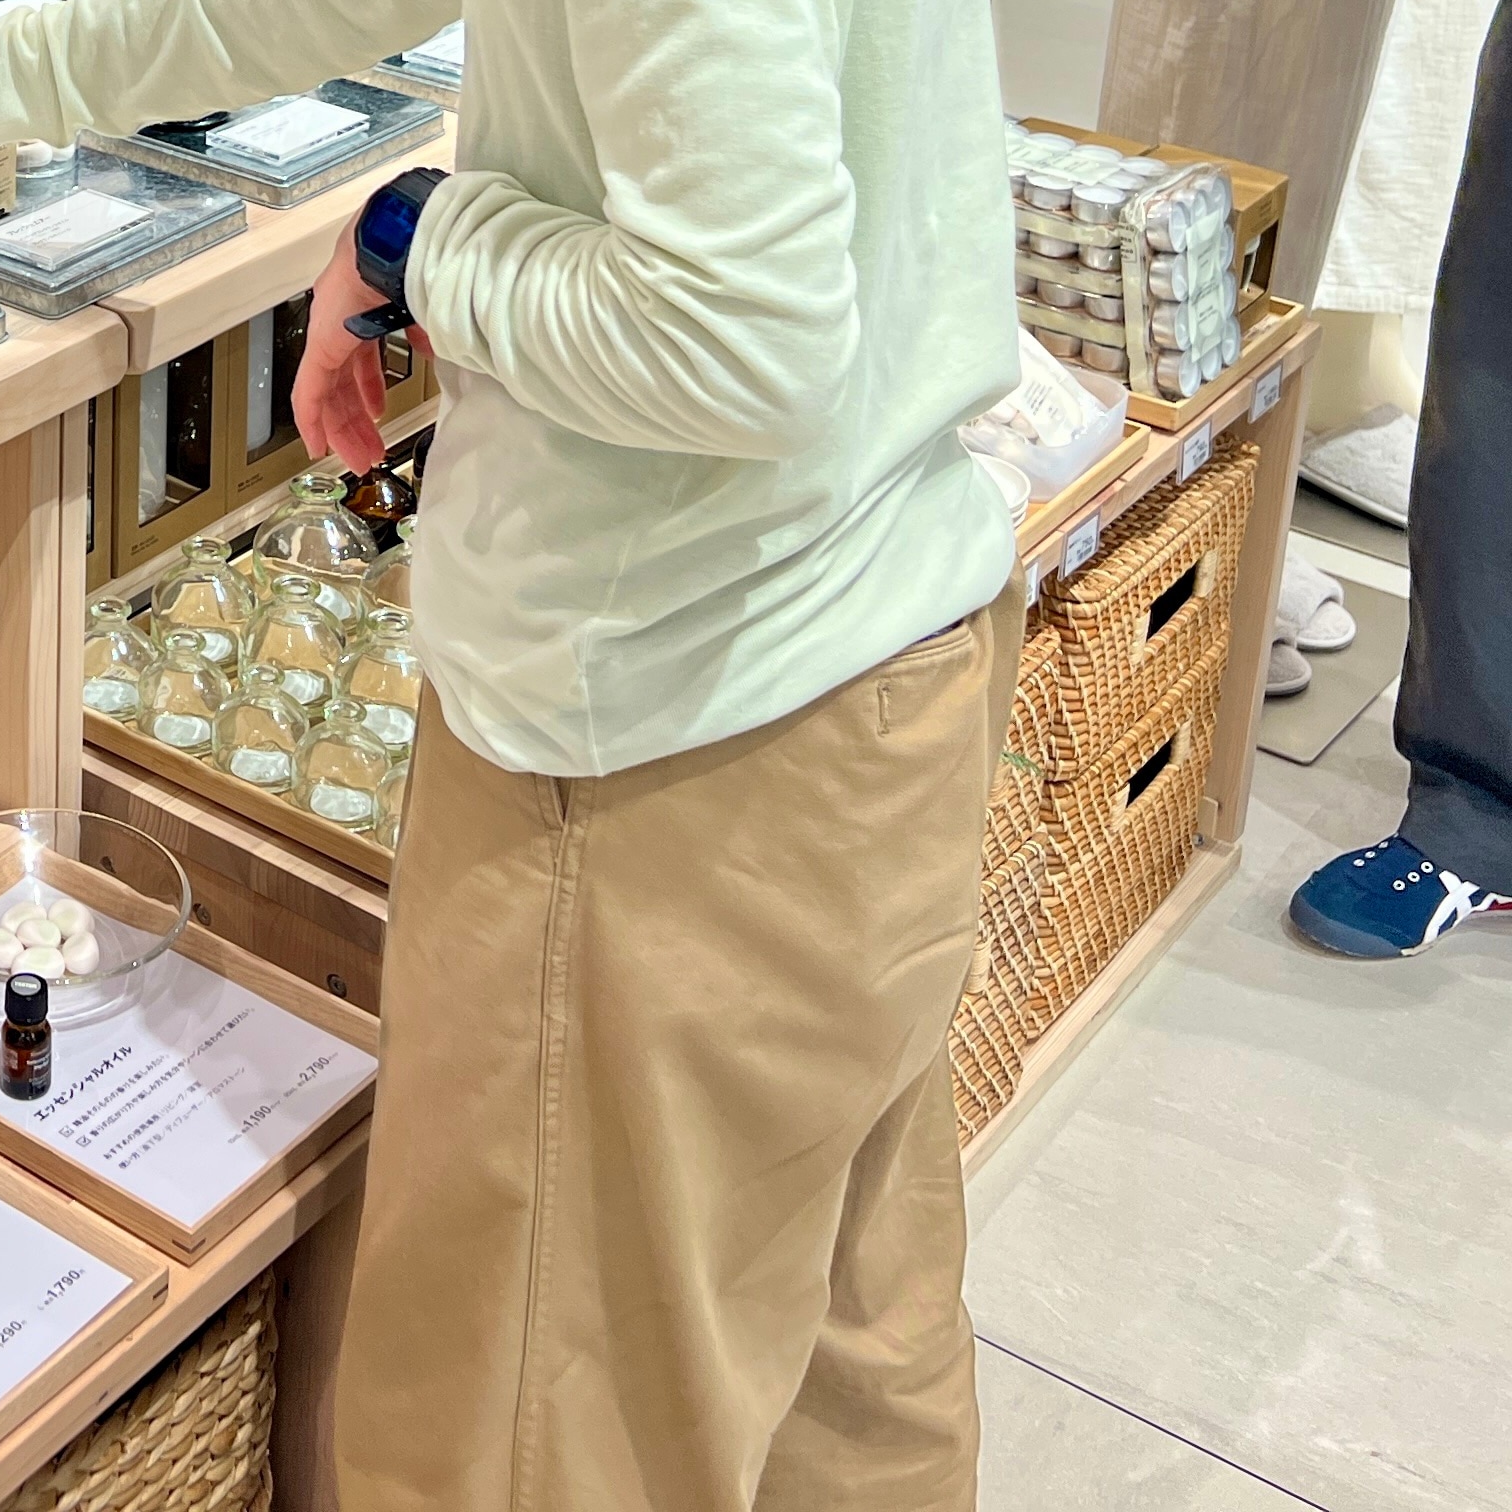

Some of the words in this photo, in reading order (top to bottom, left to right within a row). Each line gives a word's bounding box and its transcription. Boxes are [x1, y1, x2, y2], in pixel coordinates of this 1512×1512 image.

[32, 1044, 134, 1123] エッセンシャルオイル
